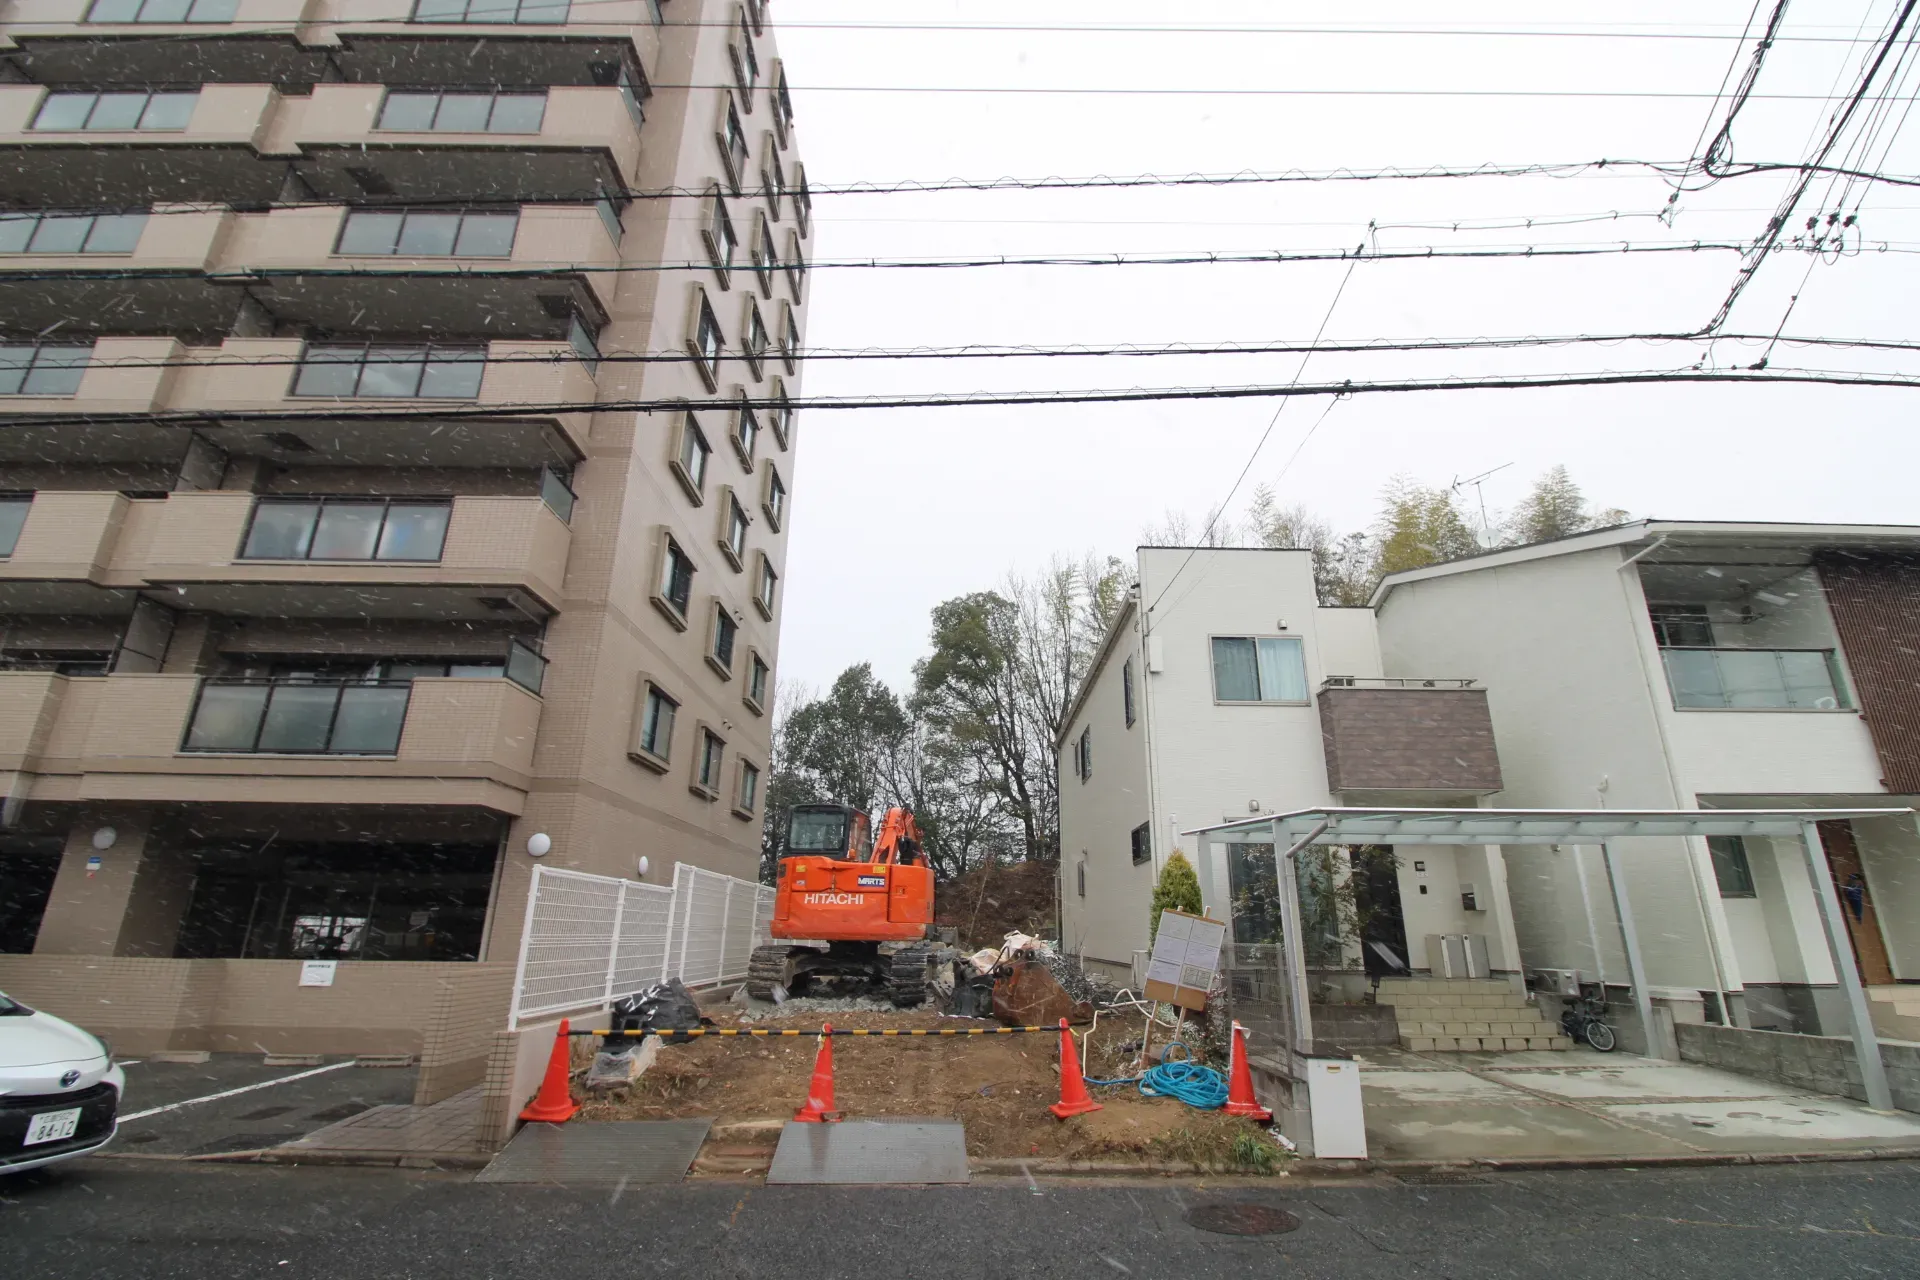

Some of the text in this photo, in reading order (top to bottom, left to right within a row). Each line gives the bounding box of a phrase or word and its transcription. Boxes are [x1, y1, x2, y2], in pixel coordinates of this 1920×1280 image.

[858, 877, 885, 886] MARTS
[804, 893, 864, 905] HITACHI
[37, 1120, 74, 1140] 84-12
